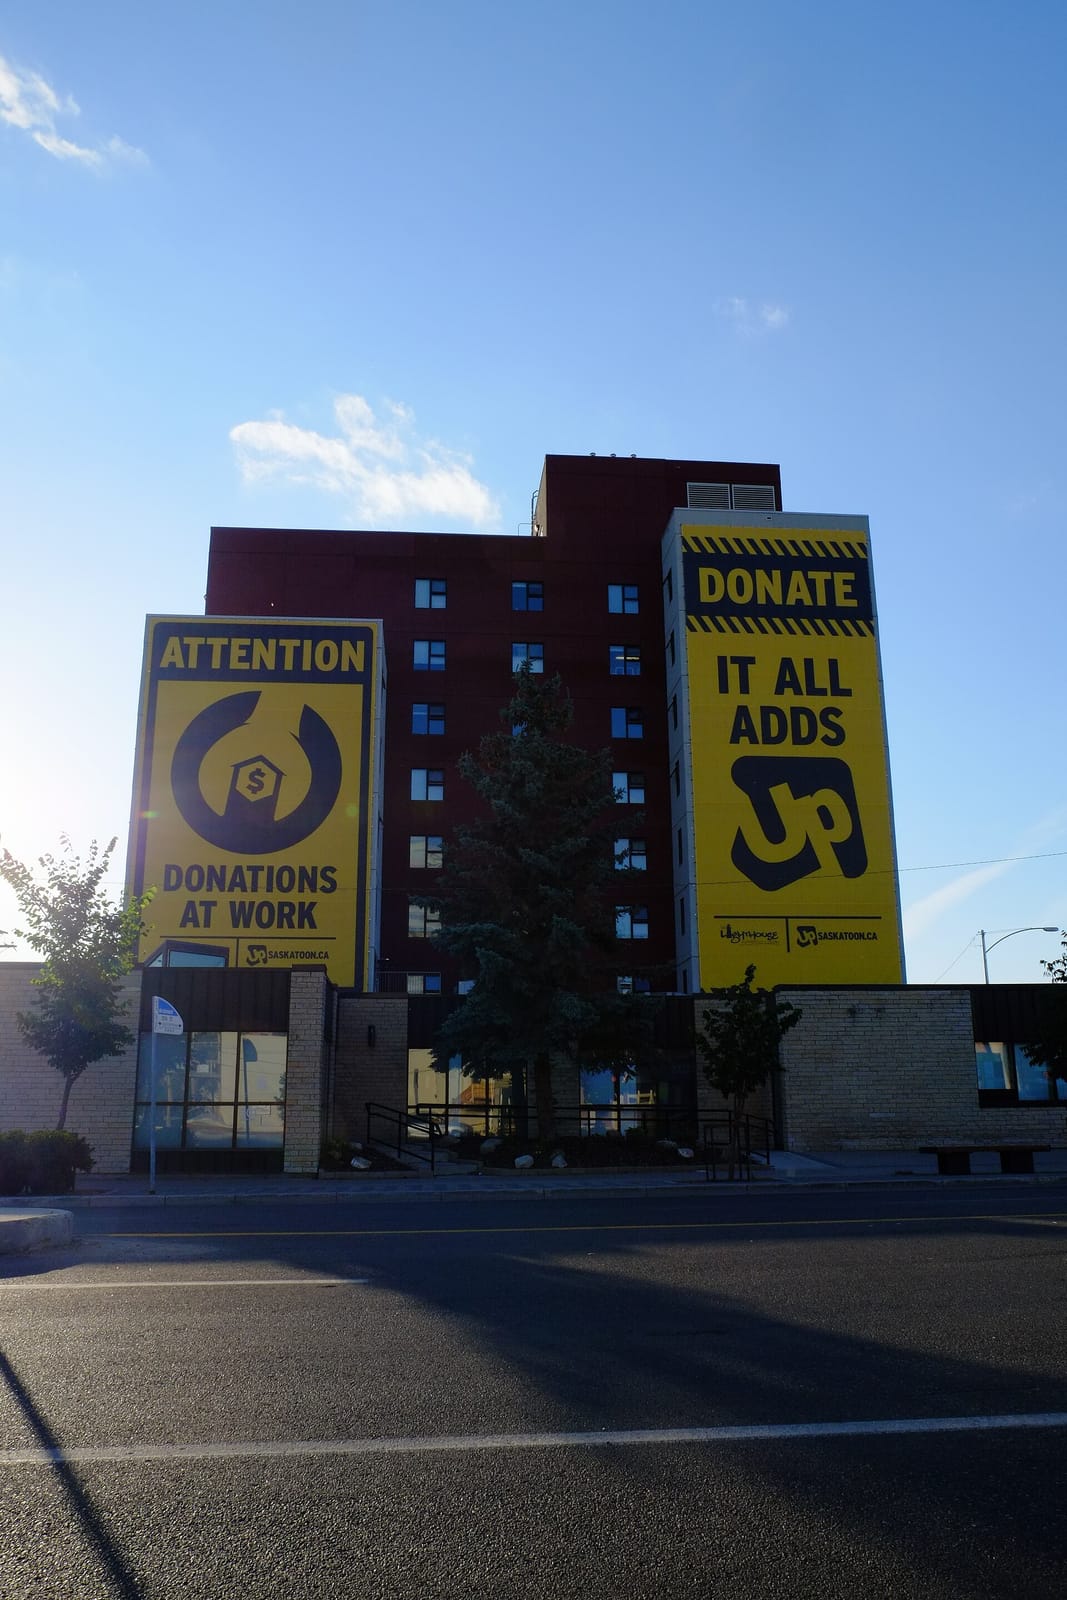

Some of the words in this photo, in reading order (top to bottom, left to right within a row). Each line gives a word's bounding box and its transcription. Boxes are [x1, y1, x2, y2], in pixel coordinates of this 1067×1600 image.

[698, 567, 858, 607] DONATE
[160, 636, 365, 672] ATTENTION
[717, 655, 756, 695] IT
[774, 657, 853, 697] ALL
[729, 705, 846, 746] ADDS
[245, 767, 265, 795] $
[163, 864, 337, 893] DONATIONS
[179, 899, 218, 929] AT
[229, 900, 318, 930] WORK
[818, 931, 878, 941] SASKATOON.CA
[268, 950, 329, 960] SASKATOON.CA
